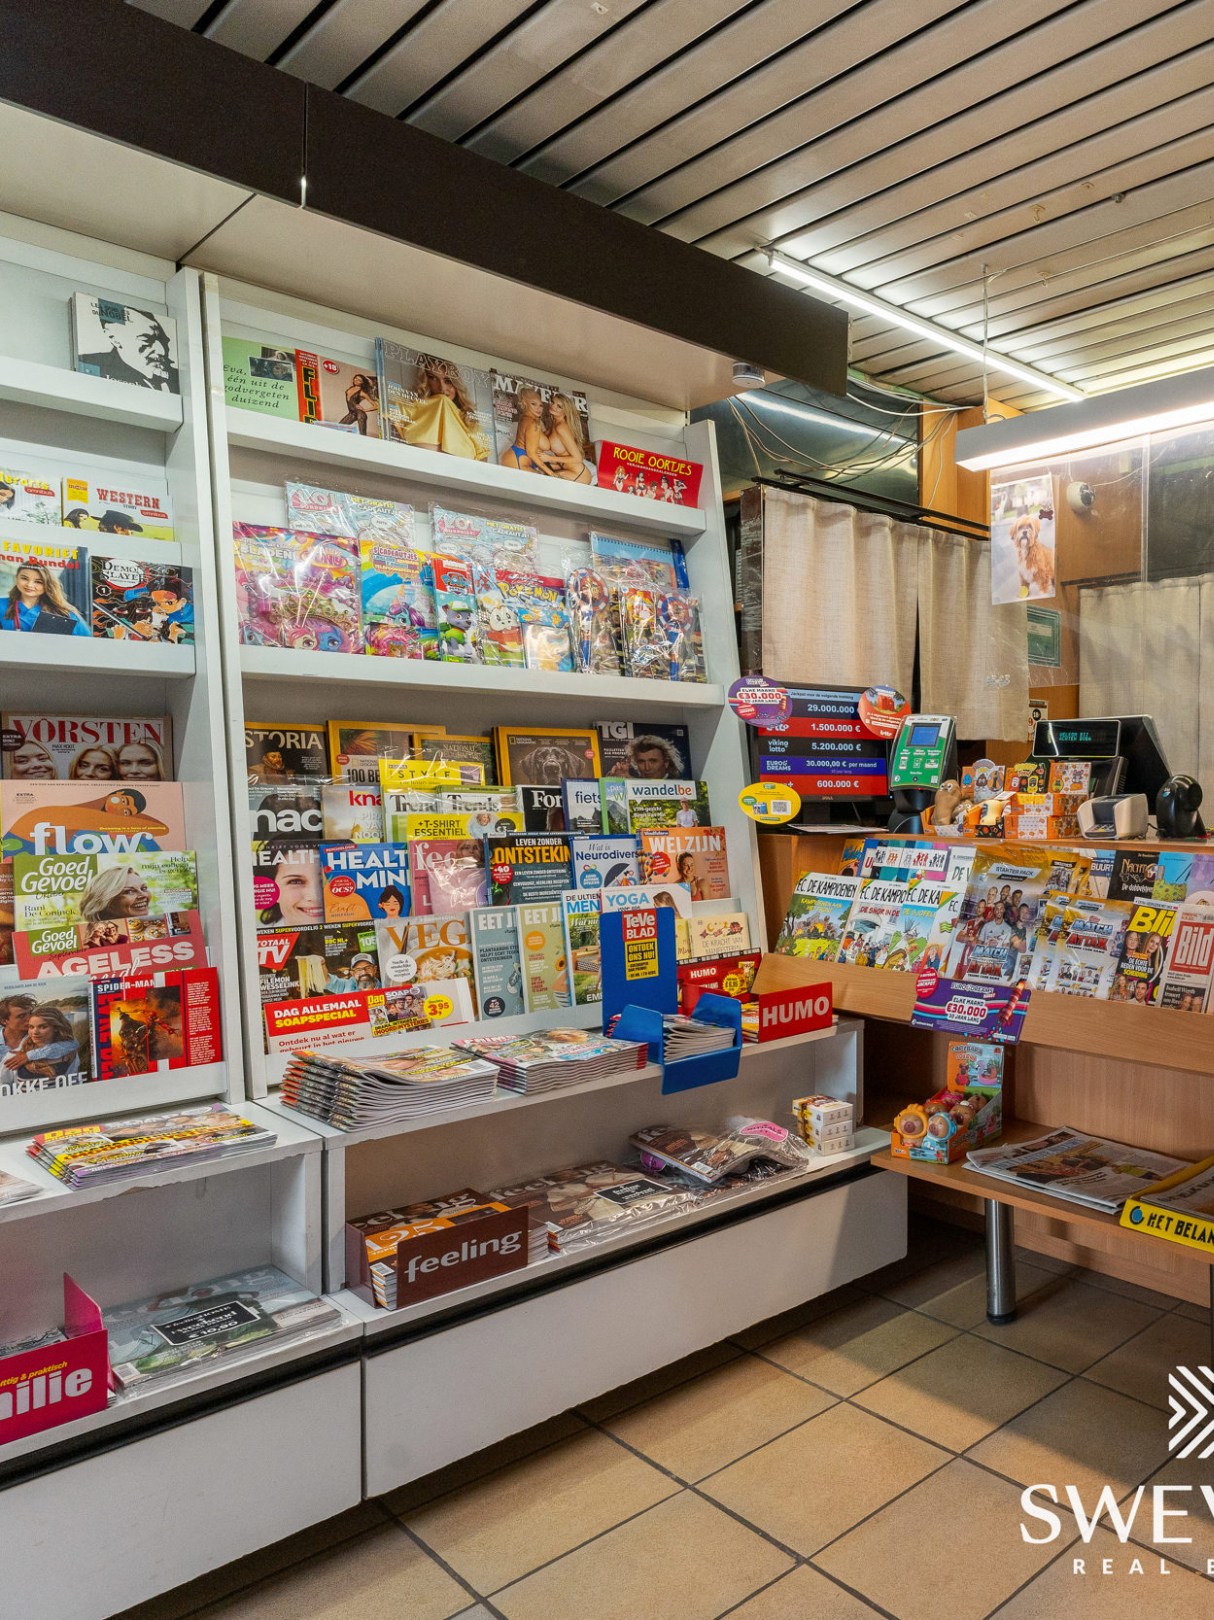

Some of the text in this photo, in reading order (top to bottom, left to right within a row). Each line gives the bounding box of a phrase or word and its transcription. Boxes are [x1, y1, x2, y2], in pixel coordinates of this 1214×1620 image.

[383, 340, 491, 388] PLAYBOY
[231, 395, 280, 409] duizend
[613, 447, 645, 464] ROOIE
[648, 456, 692, 476] OORTJES
[96, 488, 160, 510] WESTERN
[807, 703, 855, 714] 29.000.000
[12, 718, 162, 746] VORSTEN
[811, 723, 861, 733] 1.500.000 €
[811, 742, 861, 752] 5.200.000 €
[632, 784, 692, 796] wandelbe
[816, 780, 860, 788] 600.000 €
[414, 828, 467, 837] ESSENTIEL
[418, 820, 461, 829] +T-SHIRT
[30, 822, 154, 855] flow
[516, 837, 562, 847] LEVEN ZONDER
[648, 835, 721, 854] WELZIJN
[39, 857, 90, 876] Goed
[21, 869, 93, 893] Gevoel
[606, 892, 650, 908] YOGA
[478, 912, 504, 931] EET
[524, 907, 549, 925] EET
[623, 911, 656, 928] TeVe
[626, 926, 655, 940] BLAD
[1072, 920, 1114, 935] MATCH
[31, 936, 78, 954] Gevoel
[41, 930, 75, 946] Goed
[628, 943, 655, 953] ONTDEK
[37, 941, 195, 979] AGELESS
[690, 967, 717, 979] HUMO
[385, 989, 409, 999] SOAP
[273, 999, 362, 1019] DAG ALLEMAAL
[427, 1001, 450, 1018] 3,95
[762, 996, 830, 1028] HUMO
[946, 1003, 986, 1018] €30.000
[275, 1010, 357, 1028] SOAPSPECIAL
[1147, 1212, 1172, 1231] HET
[404, 1230, 523, 1284] feeling
[28, 1361, 68, 1379] praktisch
